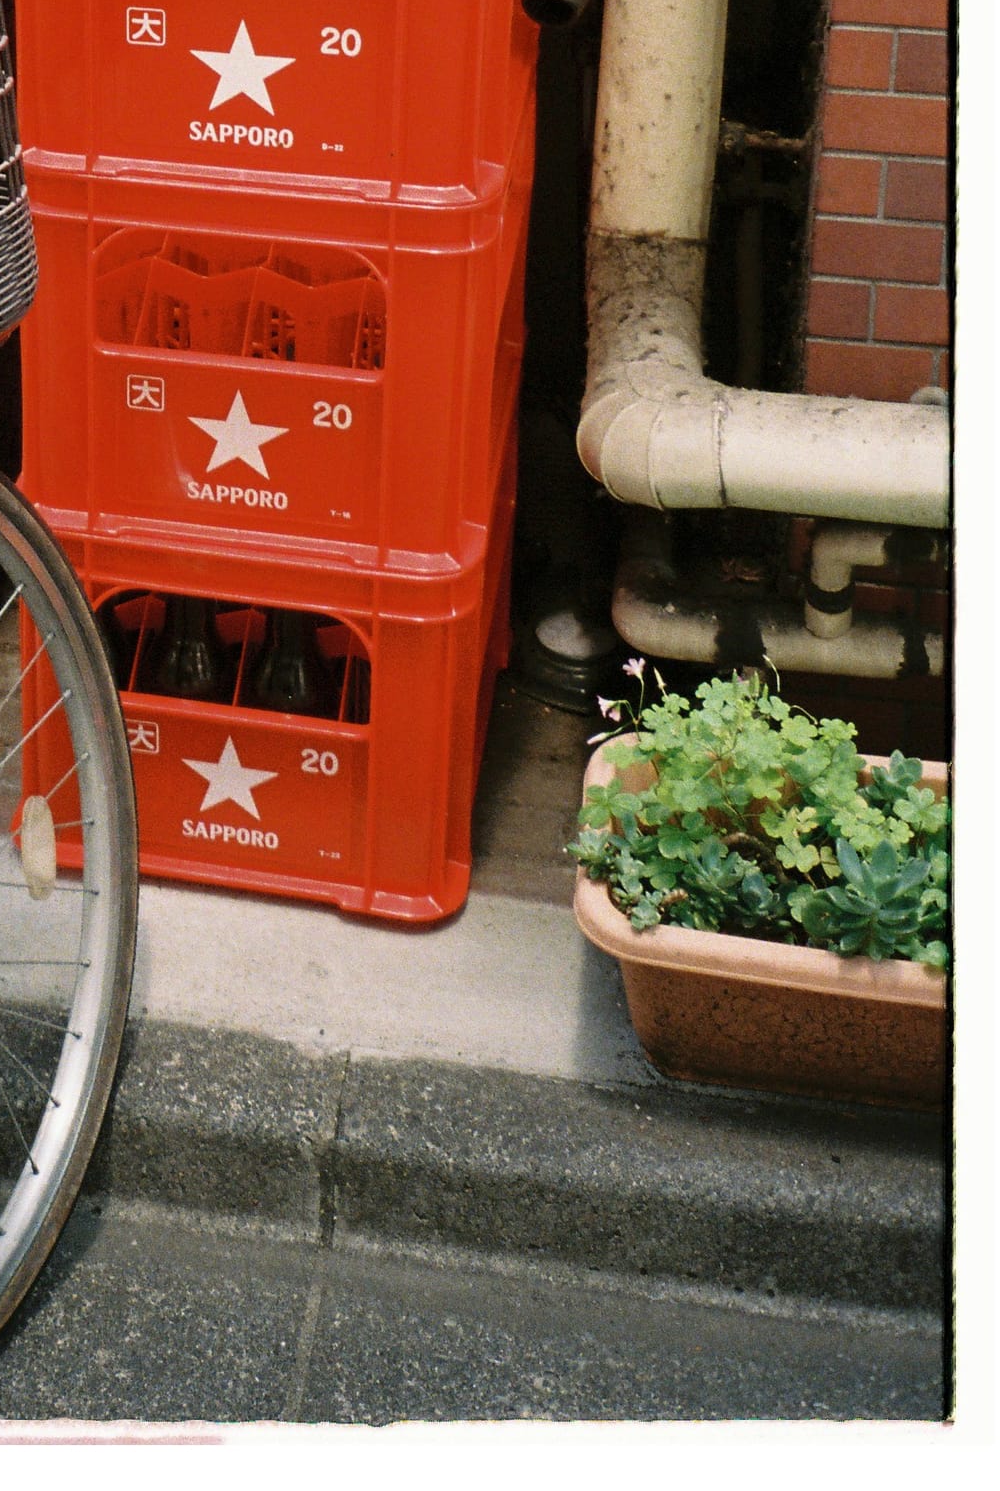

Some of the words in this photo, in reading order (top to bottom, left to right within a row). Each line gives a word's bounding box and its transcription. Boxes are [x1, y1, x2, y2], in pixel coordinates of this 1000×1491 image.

[130, 11, 162, 43] 大
[320, 27, 362, 57] 20
[189, 121, 294, 149] SAPPORO
[130, 379, 161, 408] 大
[312, 400, 353, 430] 20
[187, 481, 288, 509] SAPPORO
[129, 723, 156, 751] 大
[300, 748, 339, 776] 20
[182, 820, 279, 849] SAPPORO
